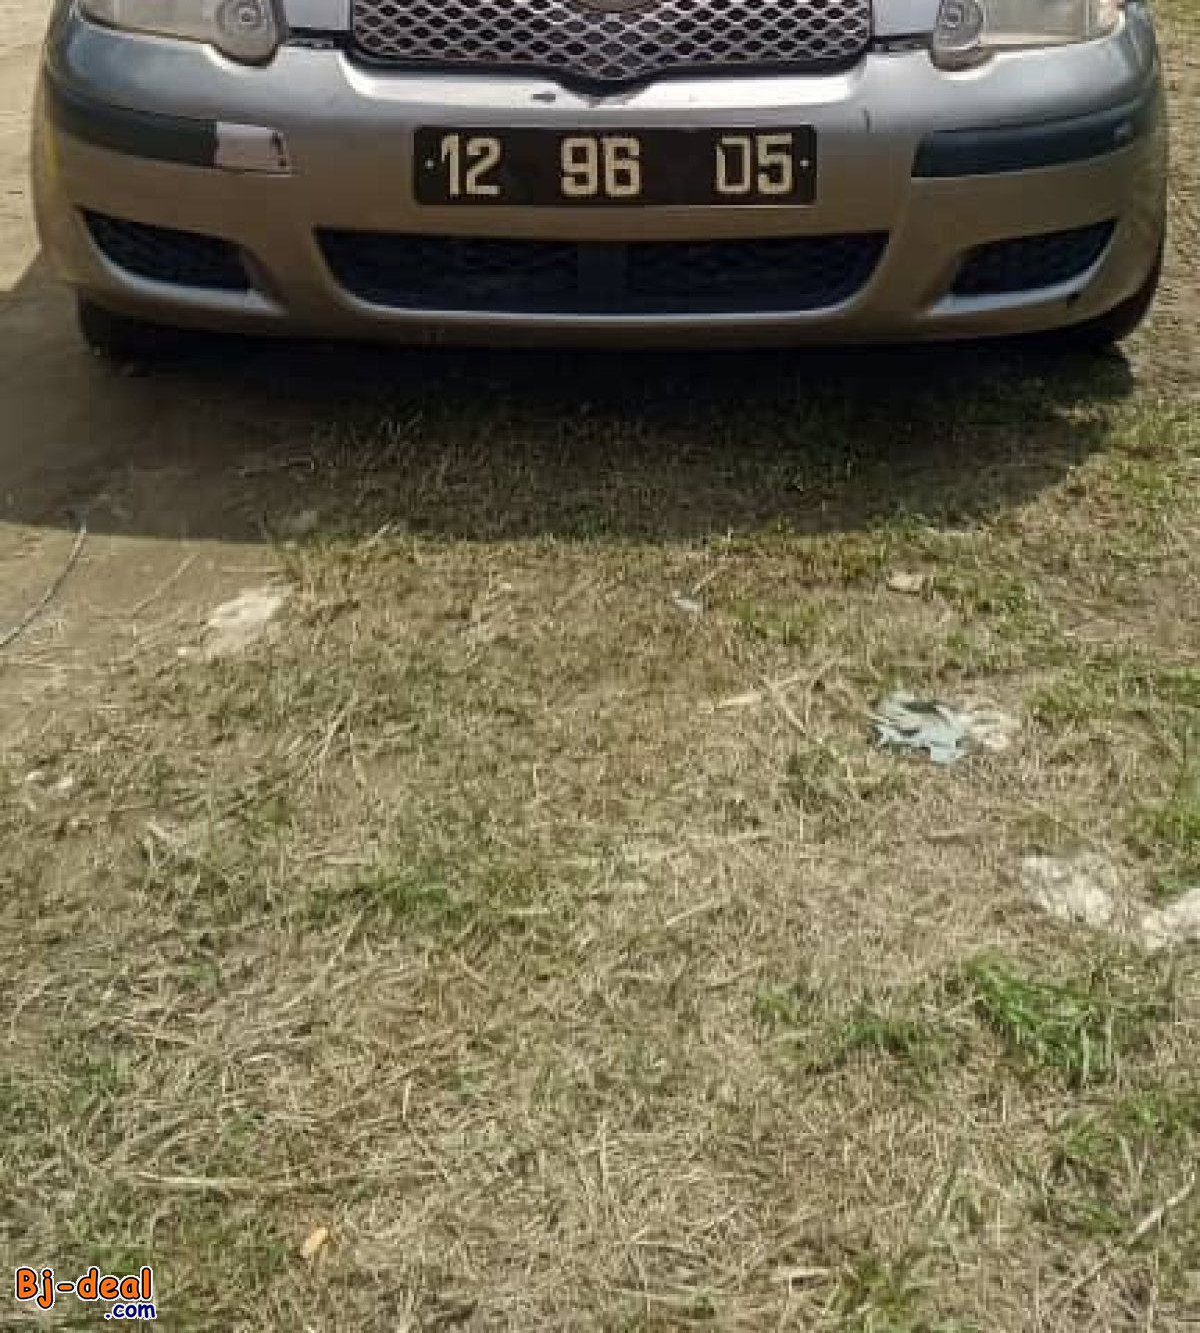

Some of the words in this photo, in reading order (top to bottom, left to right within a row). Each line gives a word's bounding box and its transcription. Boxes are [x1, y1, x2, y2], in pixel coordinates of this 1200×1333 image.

[440, 132, 501, 196] 12
[560, 136, 641, 197] 96
[715, 132, 793, 195] 05
